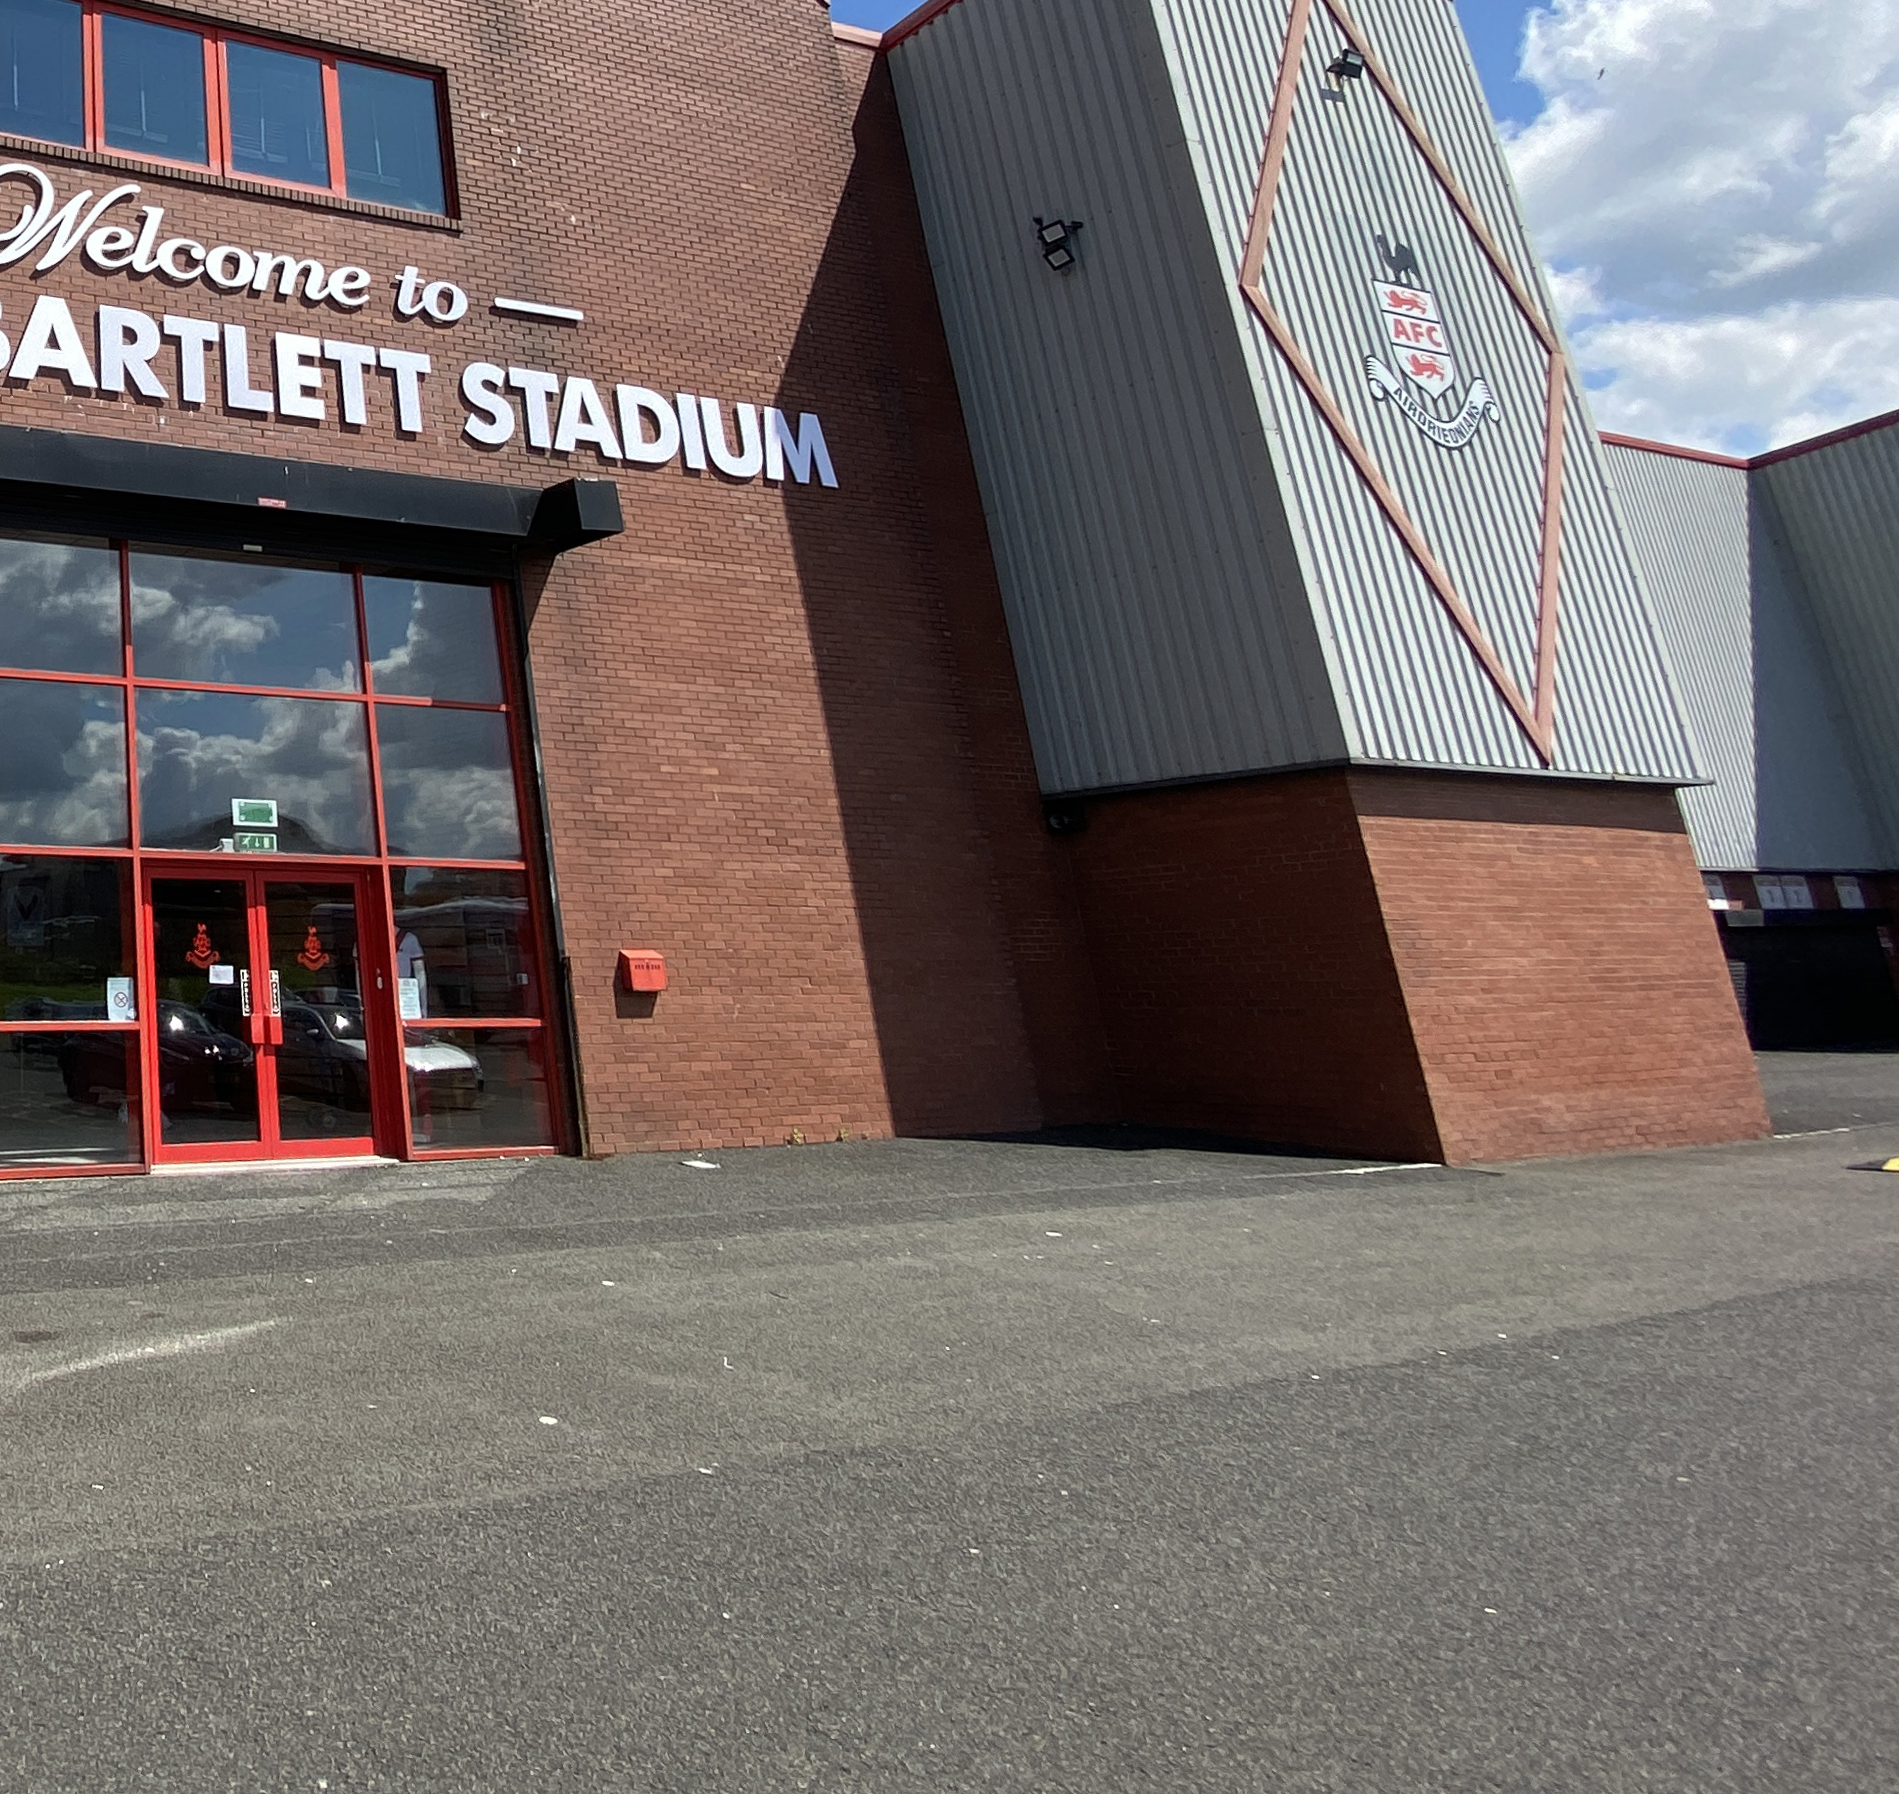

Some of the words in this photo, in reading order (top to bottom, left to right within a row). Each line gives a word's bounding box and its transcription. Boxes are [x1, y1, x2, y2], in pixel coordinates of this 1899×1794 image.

[394, 265, 469, 324] to
[1392, 317, 1443, 348] AFC
[461, 361, 839, 489] STADIUM
